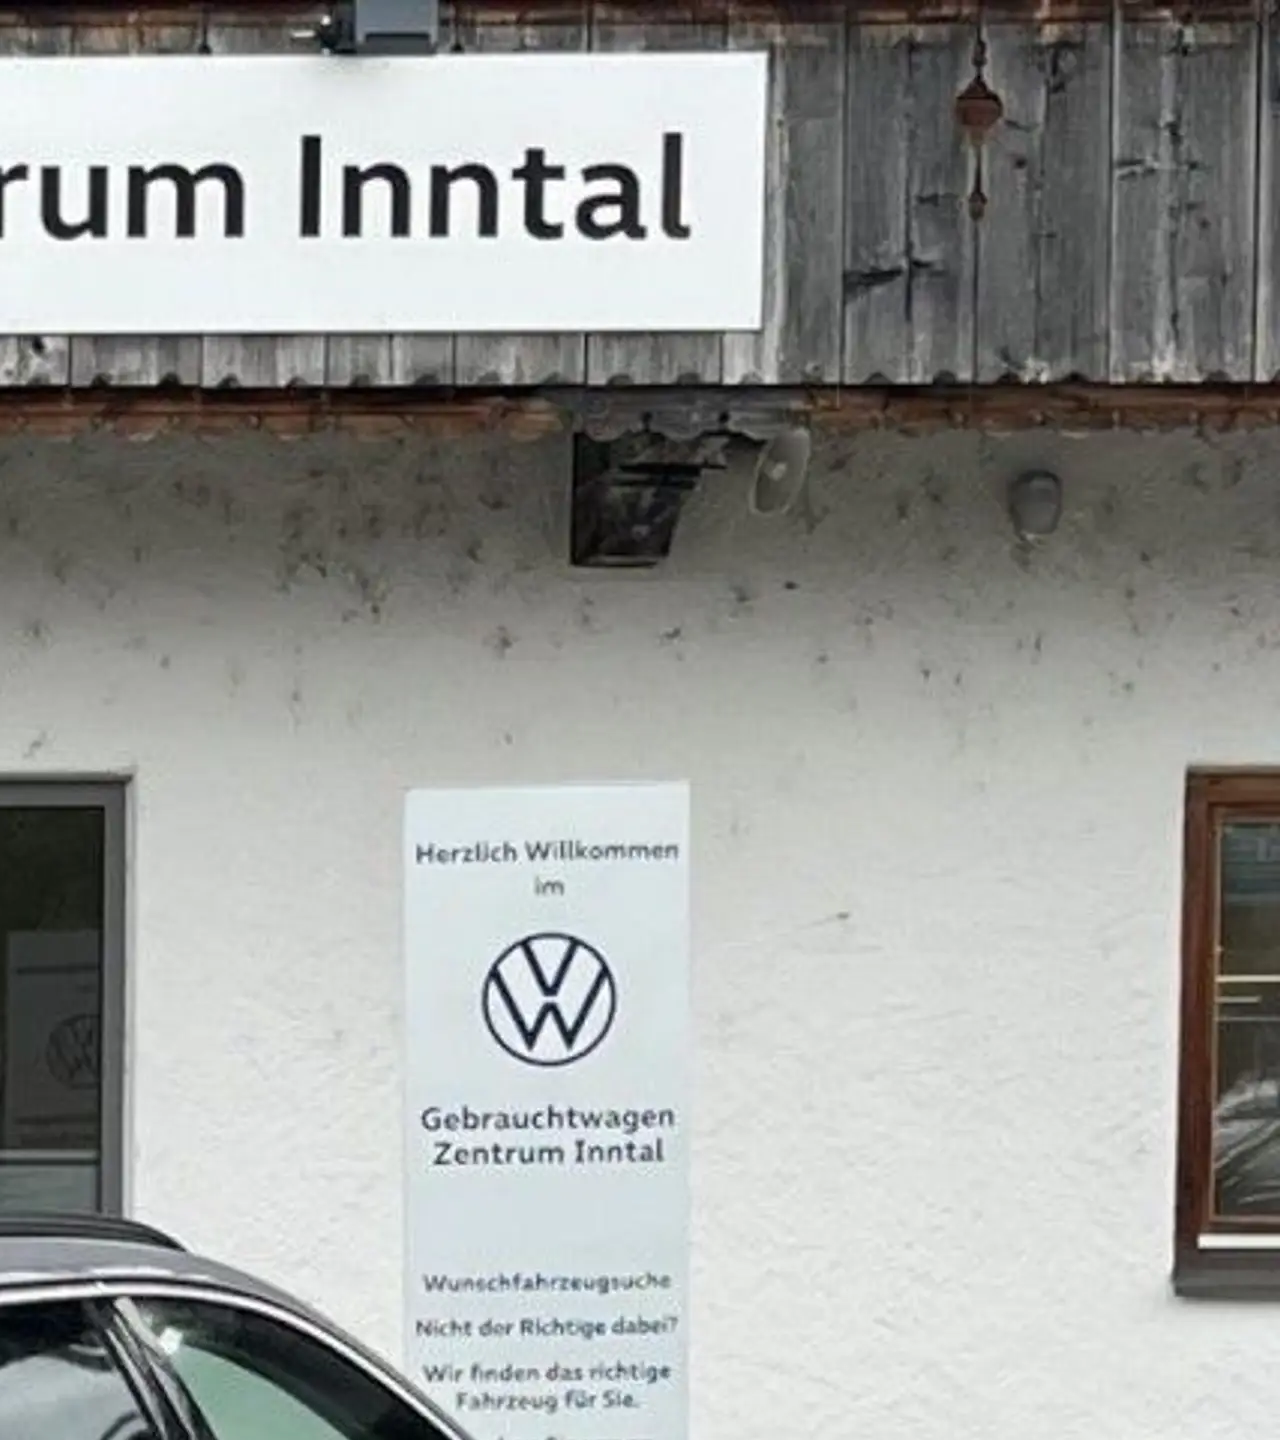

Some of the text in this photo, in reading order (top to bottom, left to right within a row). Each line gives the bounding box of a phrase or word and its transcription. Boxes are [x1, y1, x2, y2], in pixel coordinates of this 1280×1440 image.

[299, 131, 692, 242] Inntal
[415, 839, 679, 866] Herzlich Willkommen
[534, 876, 565, 896] im
[481, 932, 617, 1068] VW
[420, 1103, 676, 1135] Gebrauchtwagen
[432, 1137, 665, 1166] Zentrum Inntal
[422, 1271, 672, 1296] Wunschfahrzeugsuche
[415, 1315, 679, 1341] Nicht der Richtige dabei?
[422, 1359, 672, 1385] Wir finden das richtige
[455, 1389, 640, 1414] Fahrzeug für Sie.
